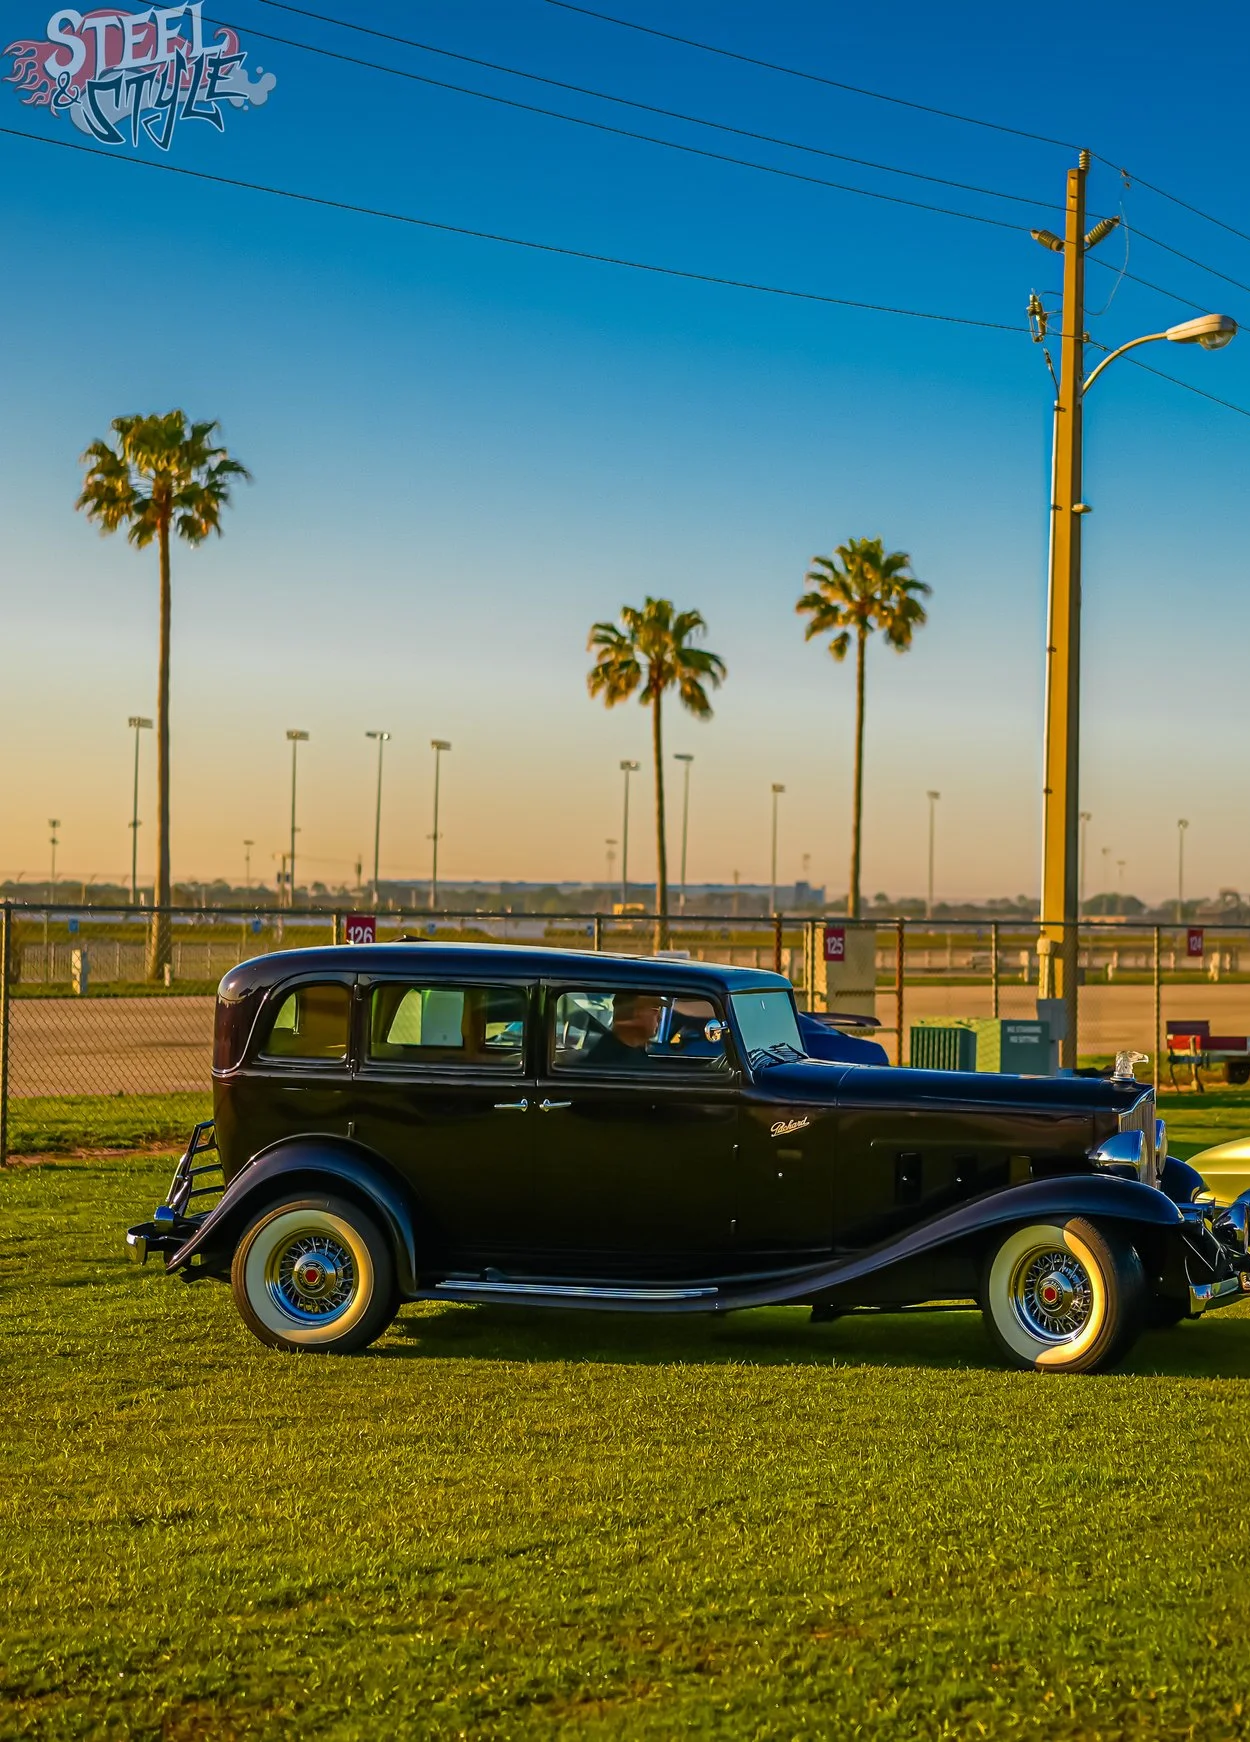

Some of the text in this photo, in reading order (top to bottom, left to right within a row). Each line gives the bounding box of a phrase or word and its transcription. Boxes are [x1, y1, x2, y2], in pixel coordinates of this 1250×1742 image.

[348, 927, 373, 944] 126
[827, 937, 843, 954] 125
[770, 1116, 810, 1137] Packard
